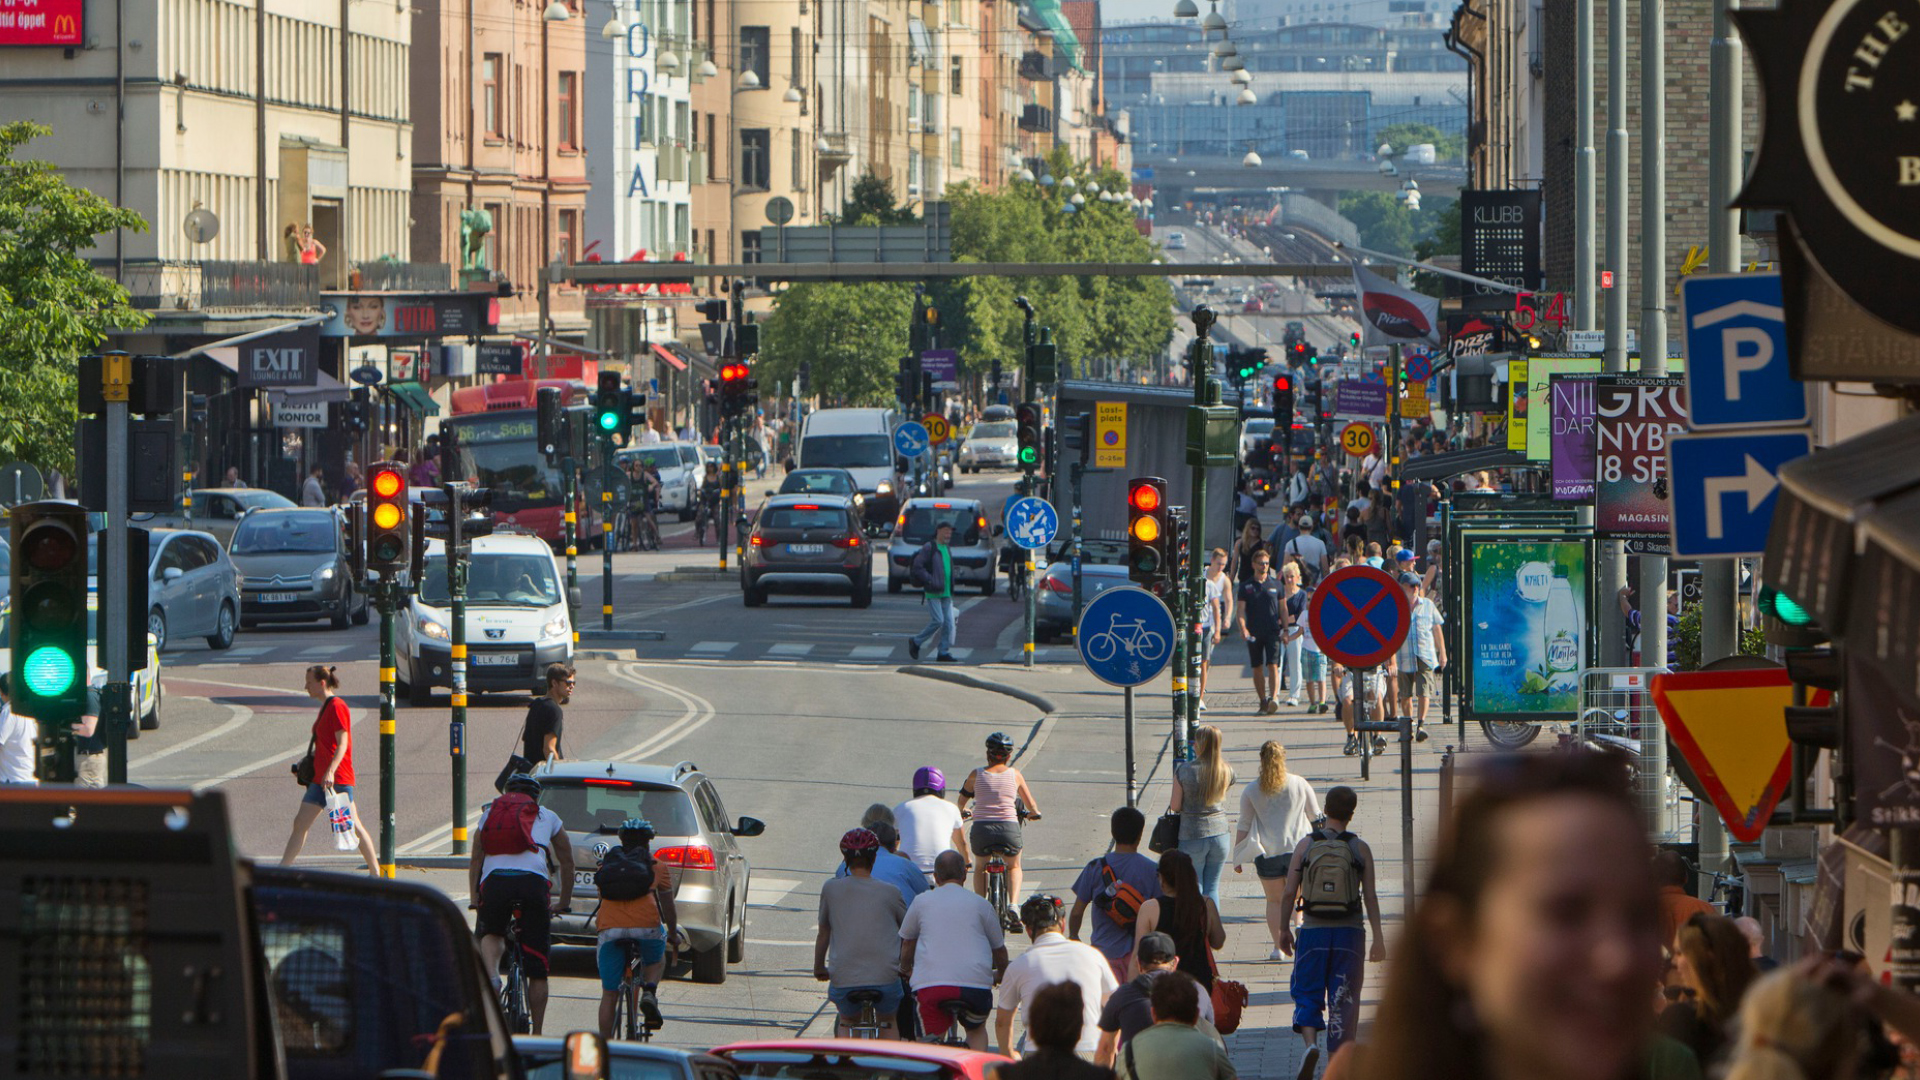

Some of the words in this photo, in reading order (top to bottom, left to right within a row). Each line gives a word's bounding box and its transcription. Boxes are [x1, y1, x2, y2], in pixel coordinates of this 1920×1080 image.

[1844, 11, 1910, 93] THE
[627, 0, 649, 198] ORIA
[1474, 205, 1524, 223] KLUBB
[393, 306, 437, 332] EVITA
[253, 348, 304, 371] EXIT
[1722, 326, 1774, 401] P
[253, 371, 280, 380] LOUNGE
[289, 371, 303, 380] BAR
[1616, 378, 1666, 386] STOCKHOLMS
[1554, 382, 1596, 416] NIL
[278, 413, 321, 423] KONTOR
[1554, 417, 1594, 435] DAR
[459, 426, 475, 440] 66
[500, 423, 533, 436] Sofia
[923, 420, 945, 437] 30
[1347, 430, 1370, 448] 30
[1597, 455, 1622, 483] 18
[1618, 513, 1669, 522] MAGASIN
[477, 656, 494, 664] LLK
[500, 655, 516, 663] 764
